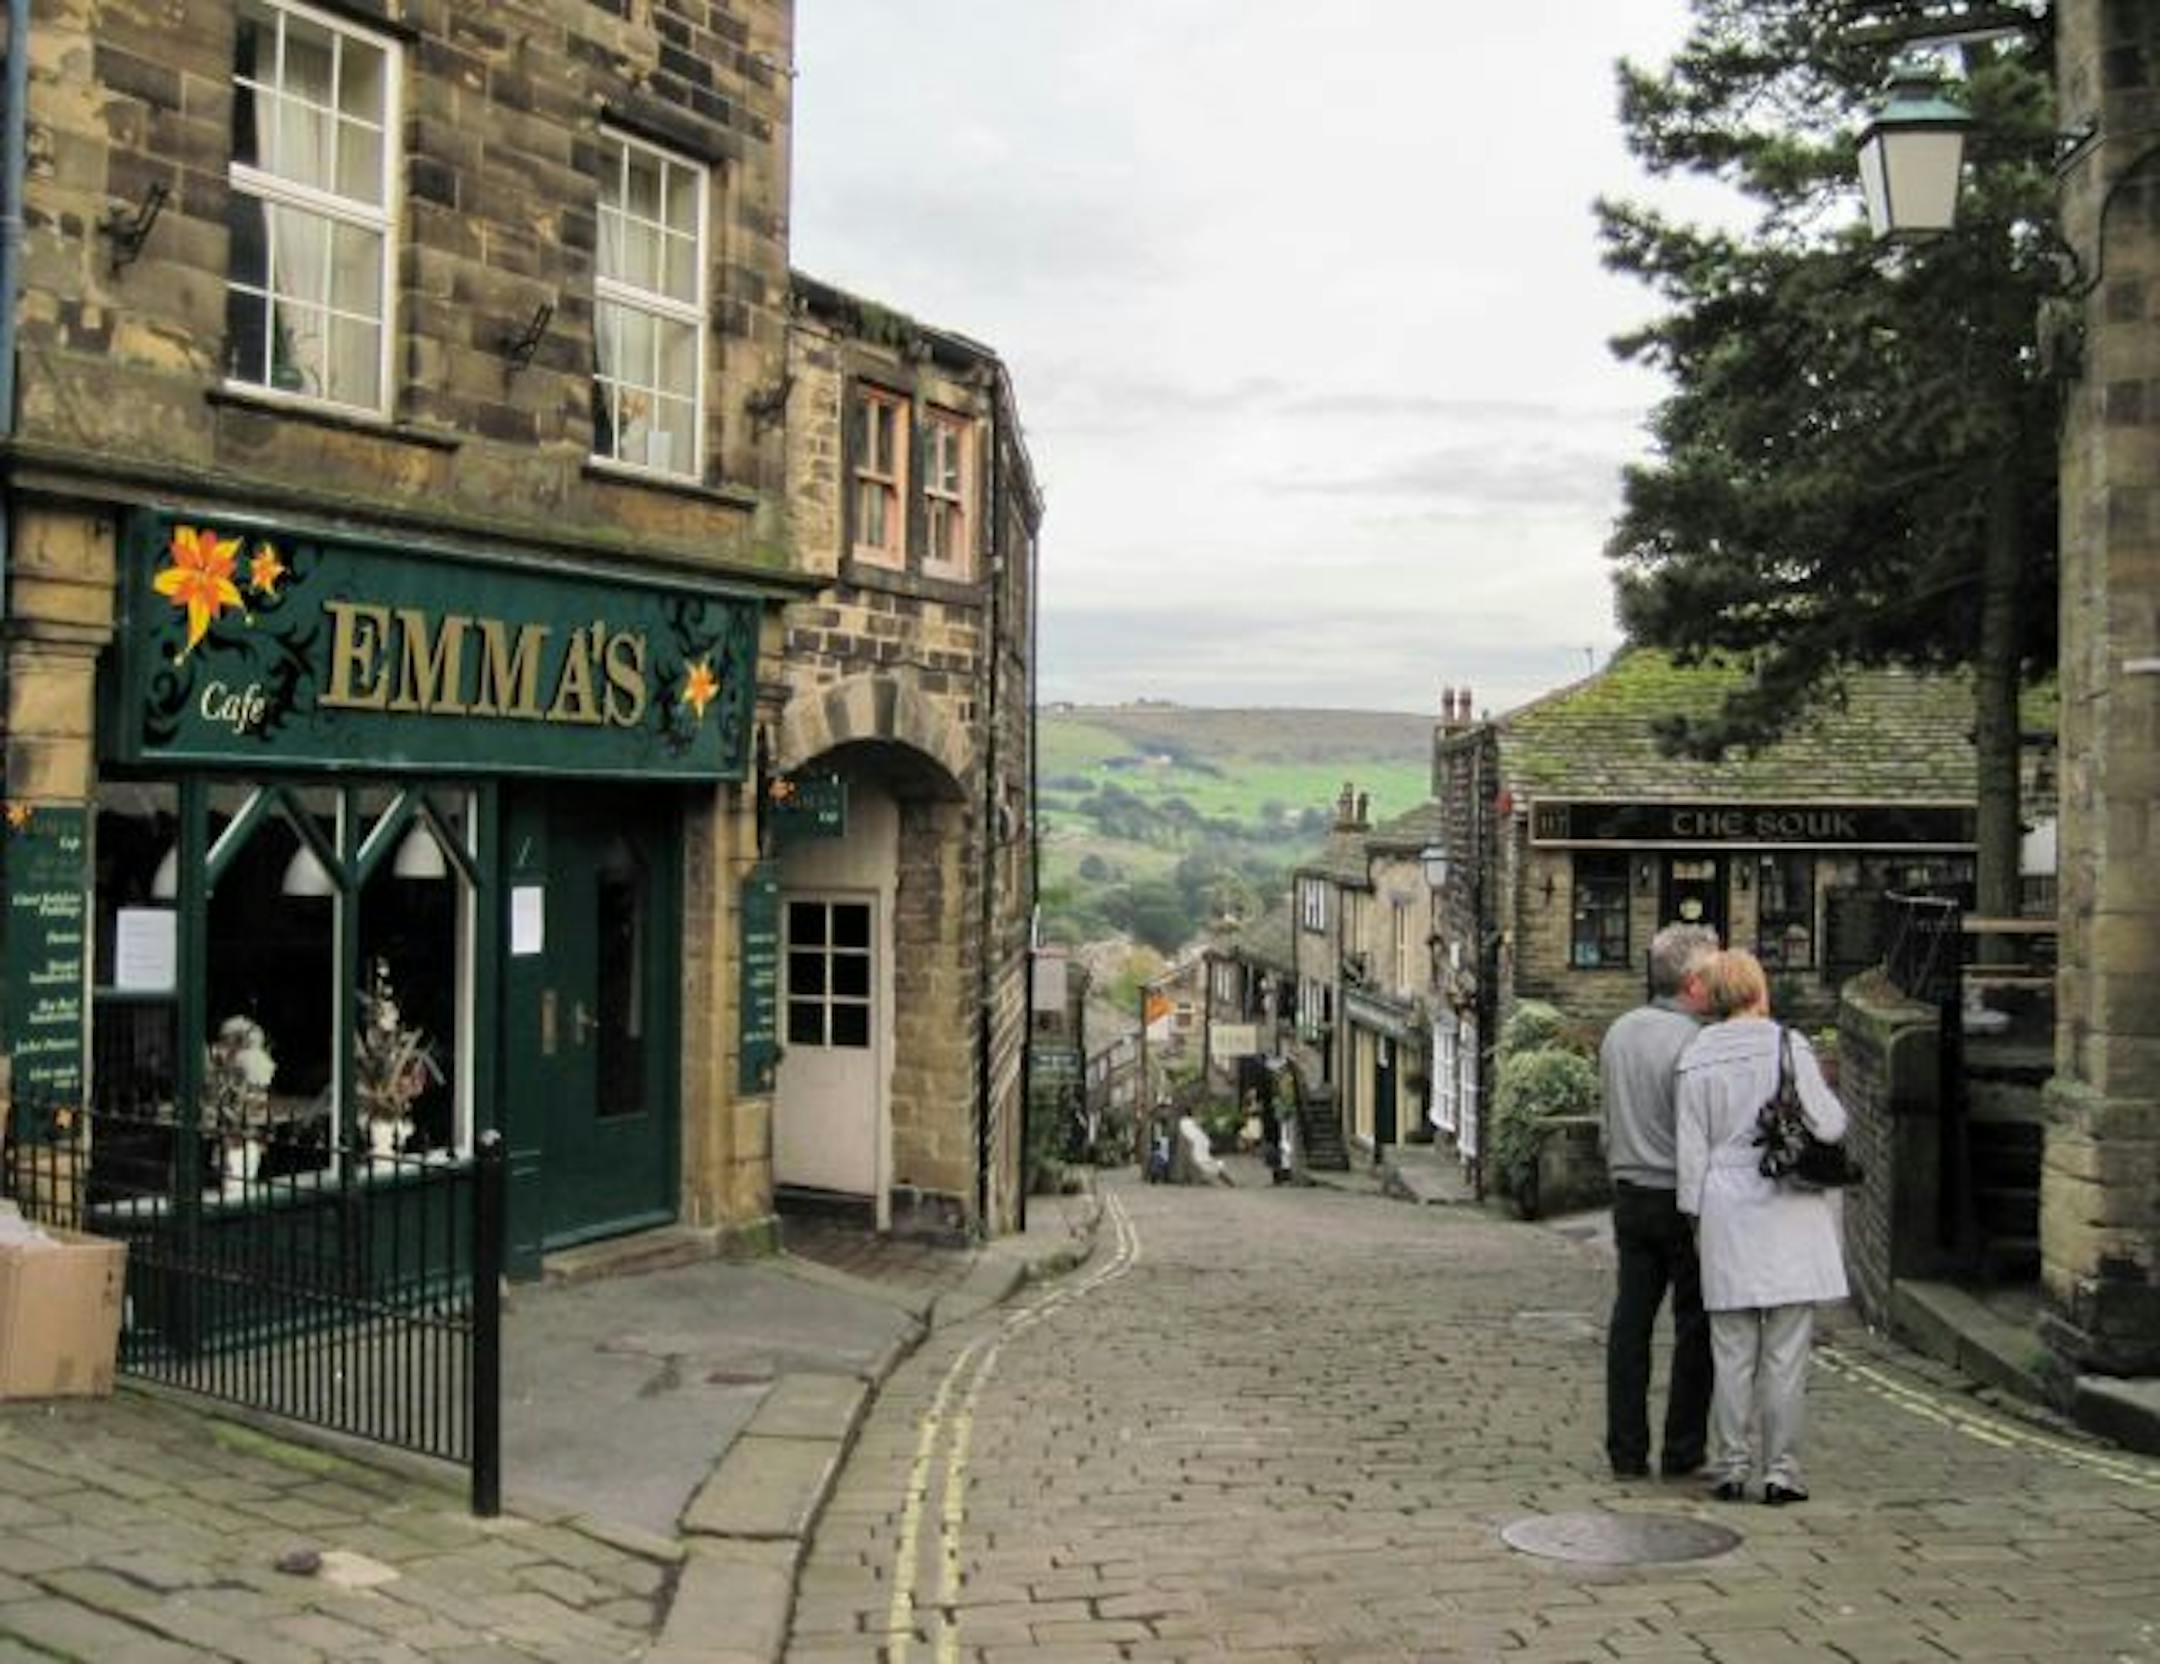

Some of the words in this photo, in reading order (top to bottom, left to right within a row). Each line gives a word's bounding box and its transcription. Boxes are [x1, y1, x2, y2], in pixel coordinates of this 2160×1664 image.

[318, 600, 647, 728] EMMA'S
[200, 681, 266, 734] Cafe
[1755, 810, 1859, 837] SOUK
